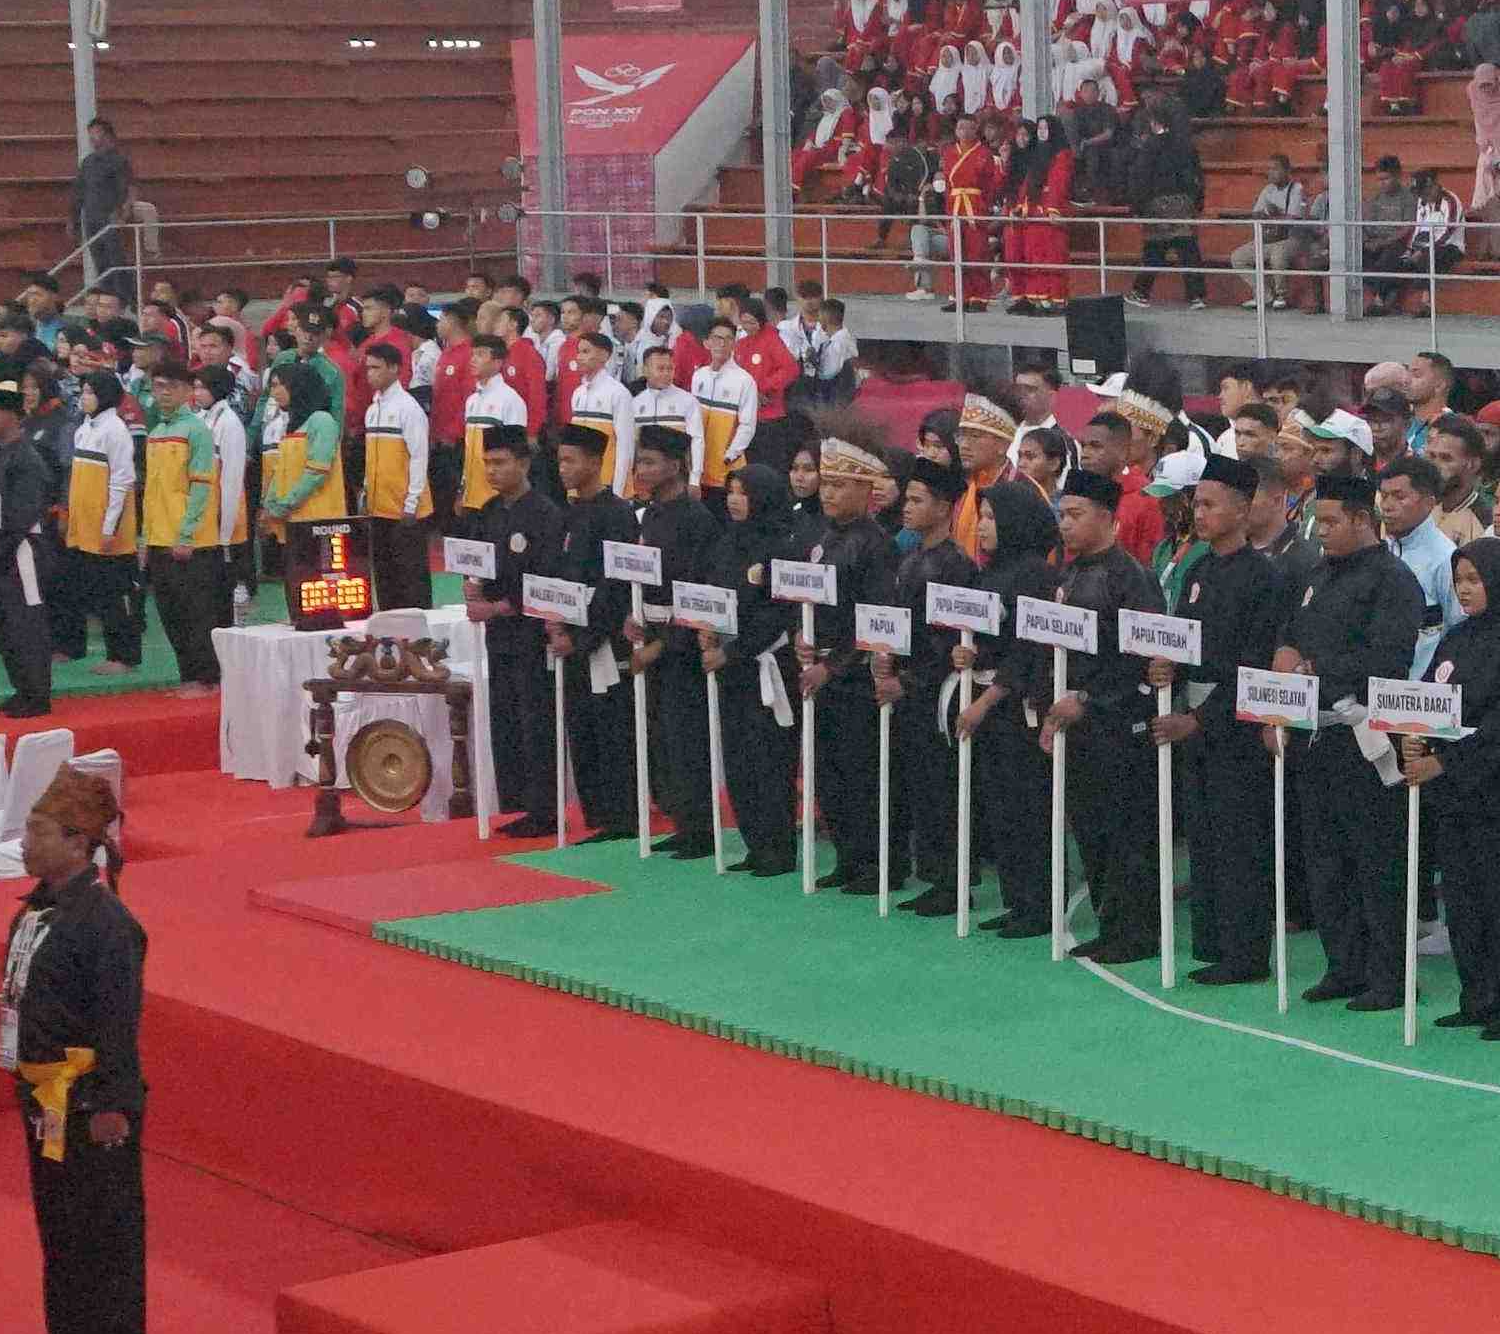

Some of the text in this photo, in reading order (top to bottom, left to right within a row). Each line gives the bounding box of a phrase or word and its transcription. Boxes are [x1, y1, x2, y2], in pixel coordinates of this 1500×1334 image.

[311, 524, 351, 536] ROUND
[869, 617, 896, 635] PAPUA
[1026, 613, 1085, 638] PAPUA SELATAN
[1131, 624, 1188, 650] PAPUA TENGAH
[1376, 692, 1453, 713] SUMATERA BARAT
